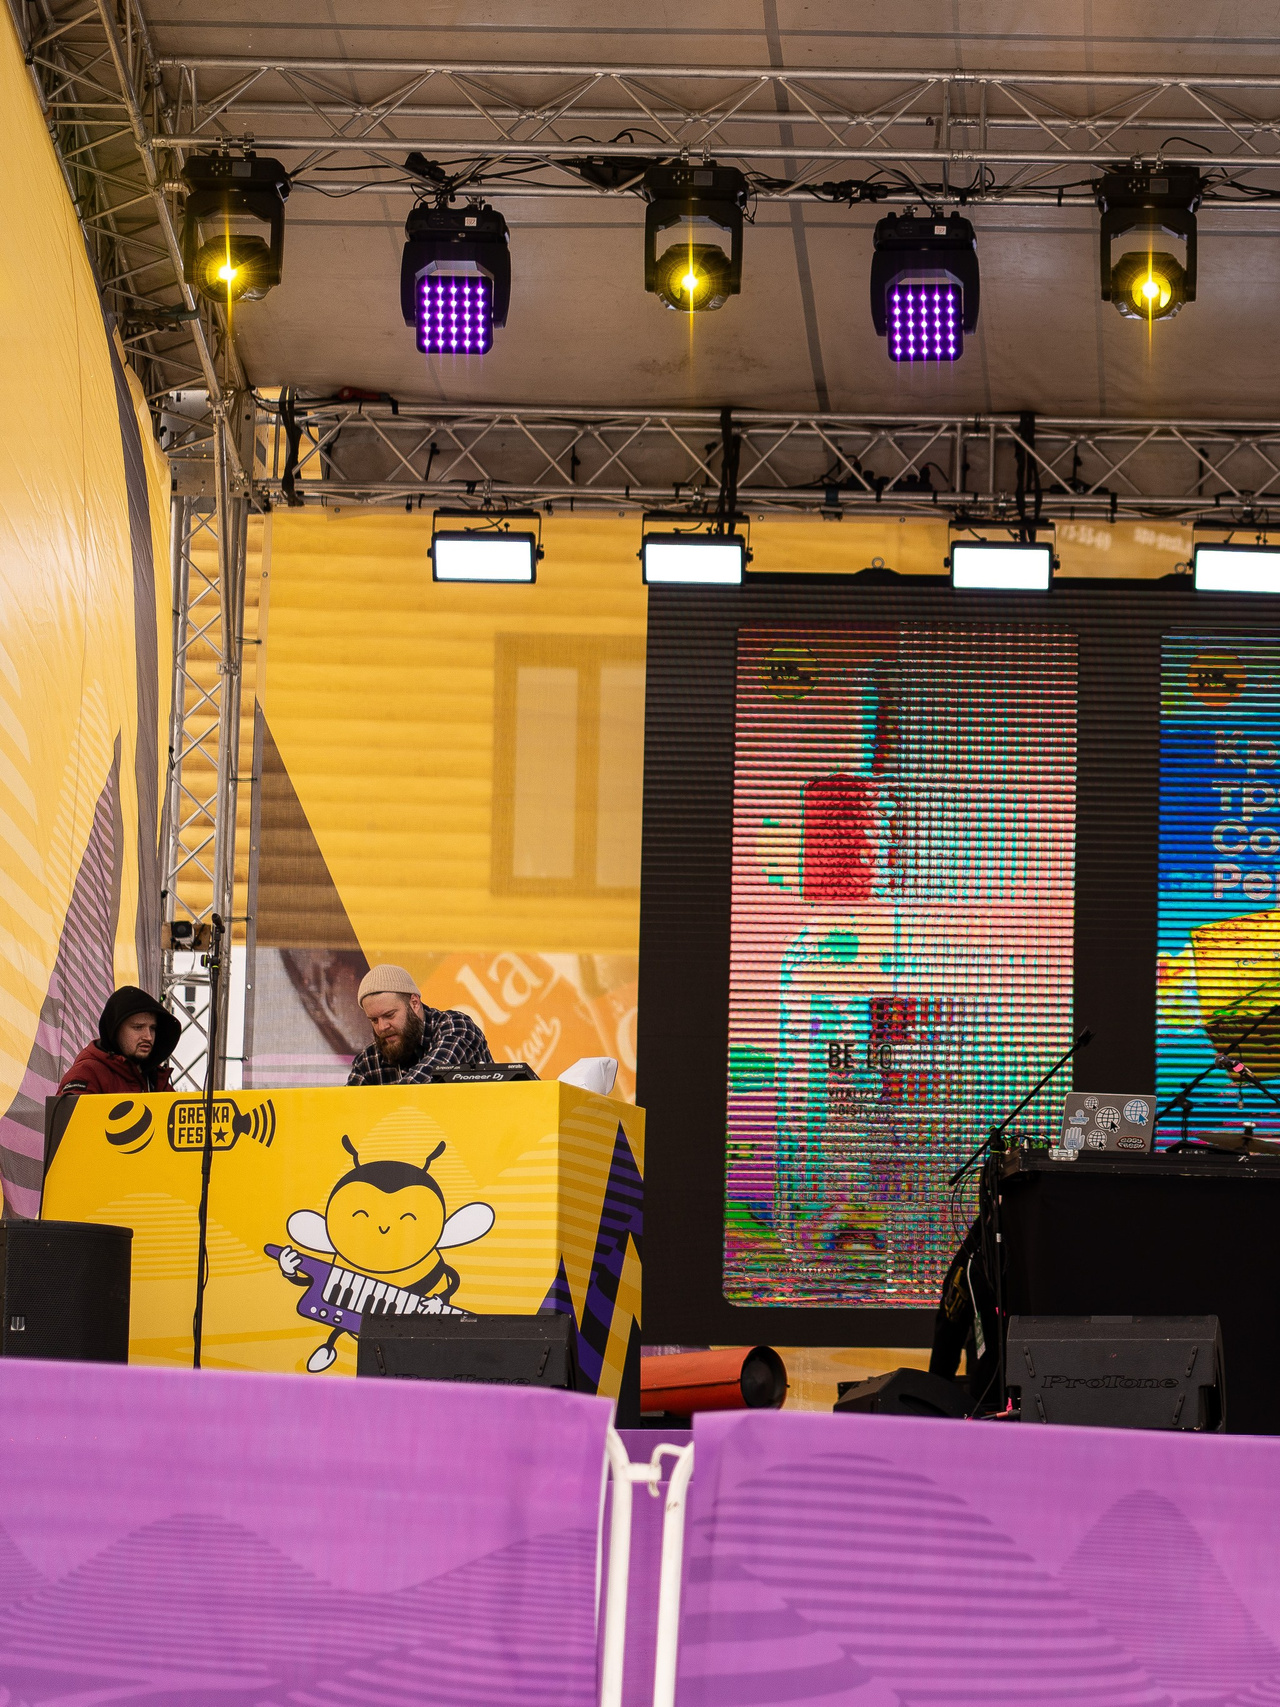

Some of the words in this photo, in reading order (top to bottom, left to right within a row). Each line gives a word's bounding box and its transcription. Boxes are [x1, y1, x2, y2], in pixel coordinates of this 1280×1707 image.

[828, 1043, 855, 1069] BE
[452, 1073, 491, 1081] Pioneer
[178, 1106, 230, 1125] GREKA
[178, 1126, 212, 1145] FES
[1041, 1375, 1180, 1389] ProTone
